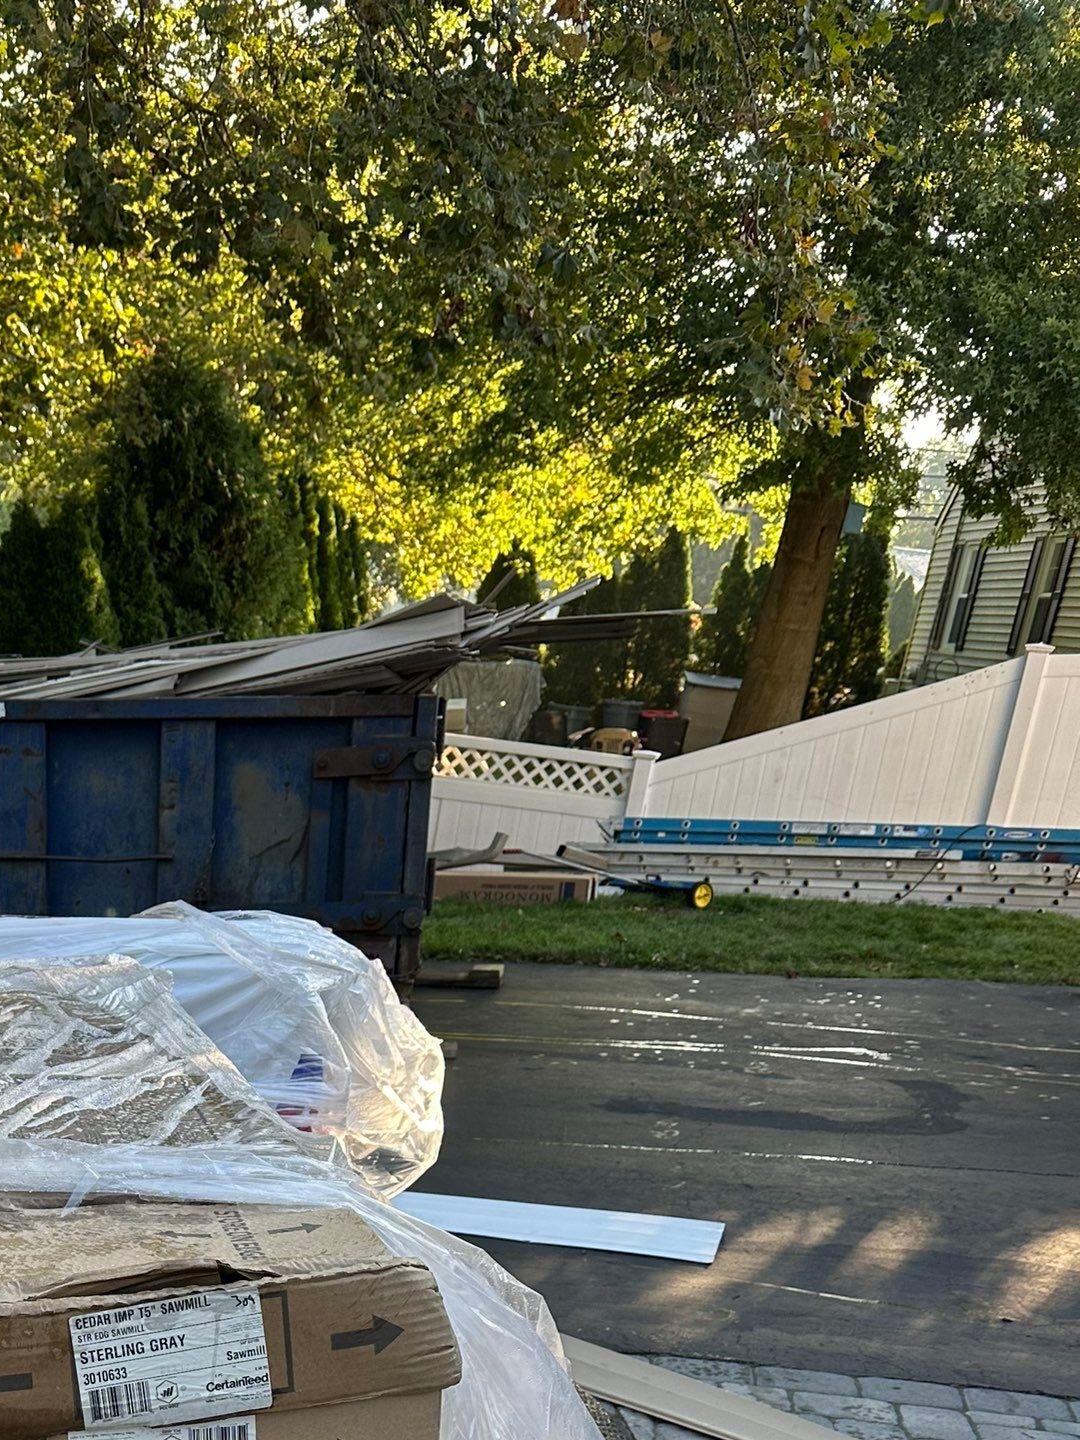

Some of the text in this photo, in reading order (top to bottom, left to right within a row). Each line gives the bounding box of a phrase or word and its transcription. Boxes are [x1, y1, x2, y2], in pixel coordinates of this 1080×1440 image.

[76, 1296, 210, 1330] CEDAR IMP T5" SAWMILL
[78, 1325, 145, 1343] STR EDG SAWMILL
[80, 1334, 186, 1364] STERLING GRAY
[226, 1345, 266, 1361] Sawmill
[83, 1367, 128, 1386] 3010633
[206, 1373, 268, 1392] CertainTeed
